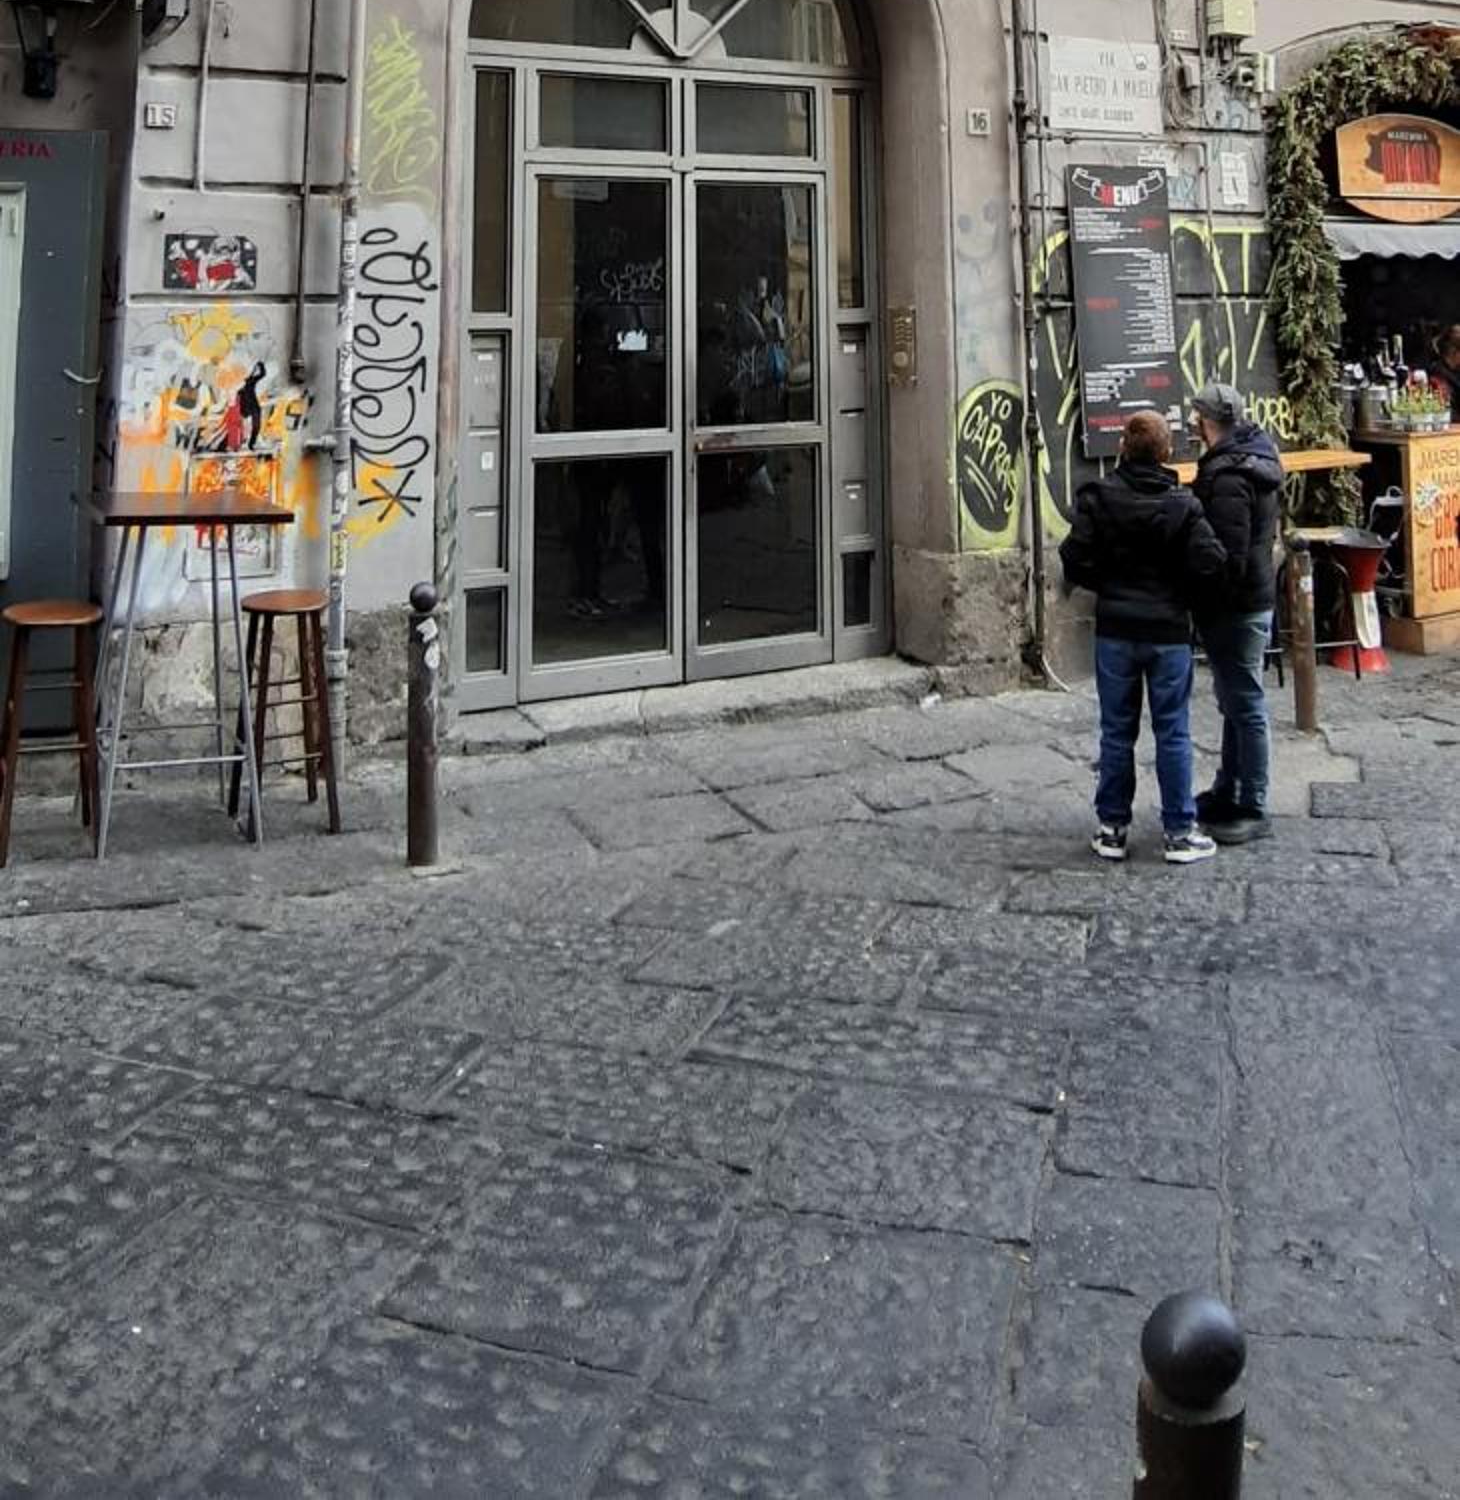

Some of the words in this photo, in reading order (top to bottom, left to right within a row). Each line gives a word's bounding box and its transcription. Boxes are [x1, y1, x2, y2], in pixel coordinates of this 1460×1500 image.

[1098, 51, 1116, 67] VIA
[150, 106, 173, 125] 15
[972, 112, 988, 131] 16
[990, 391, 1012, 420] YO
